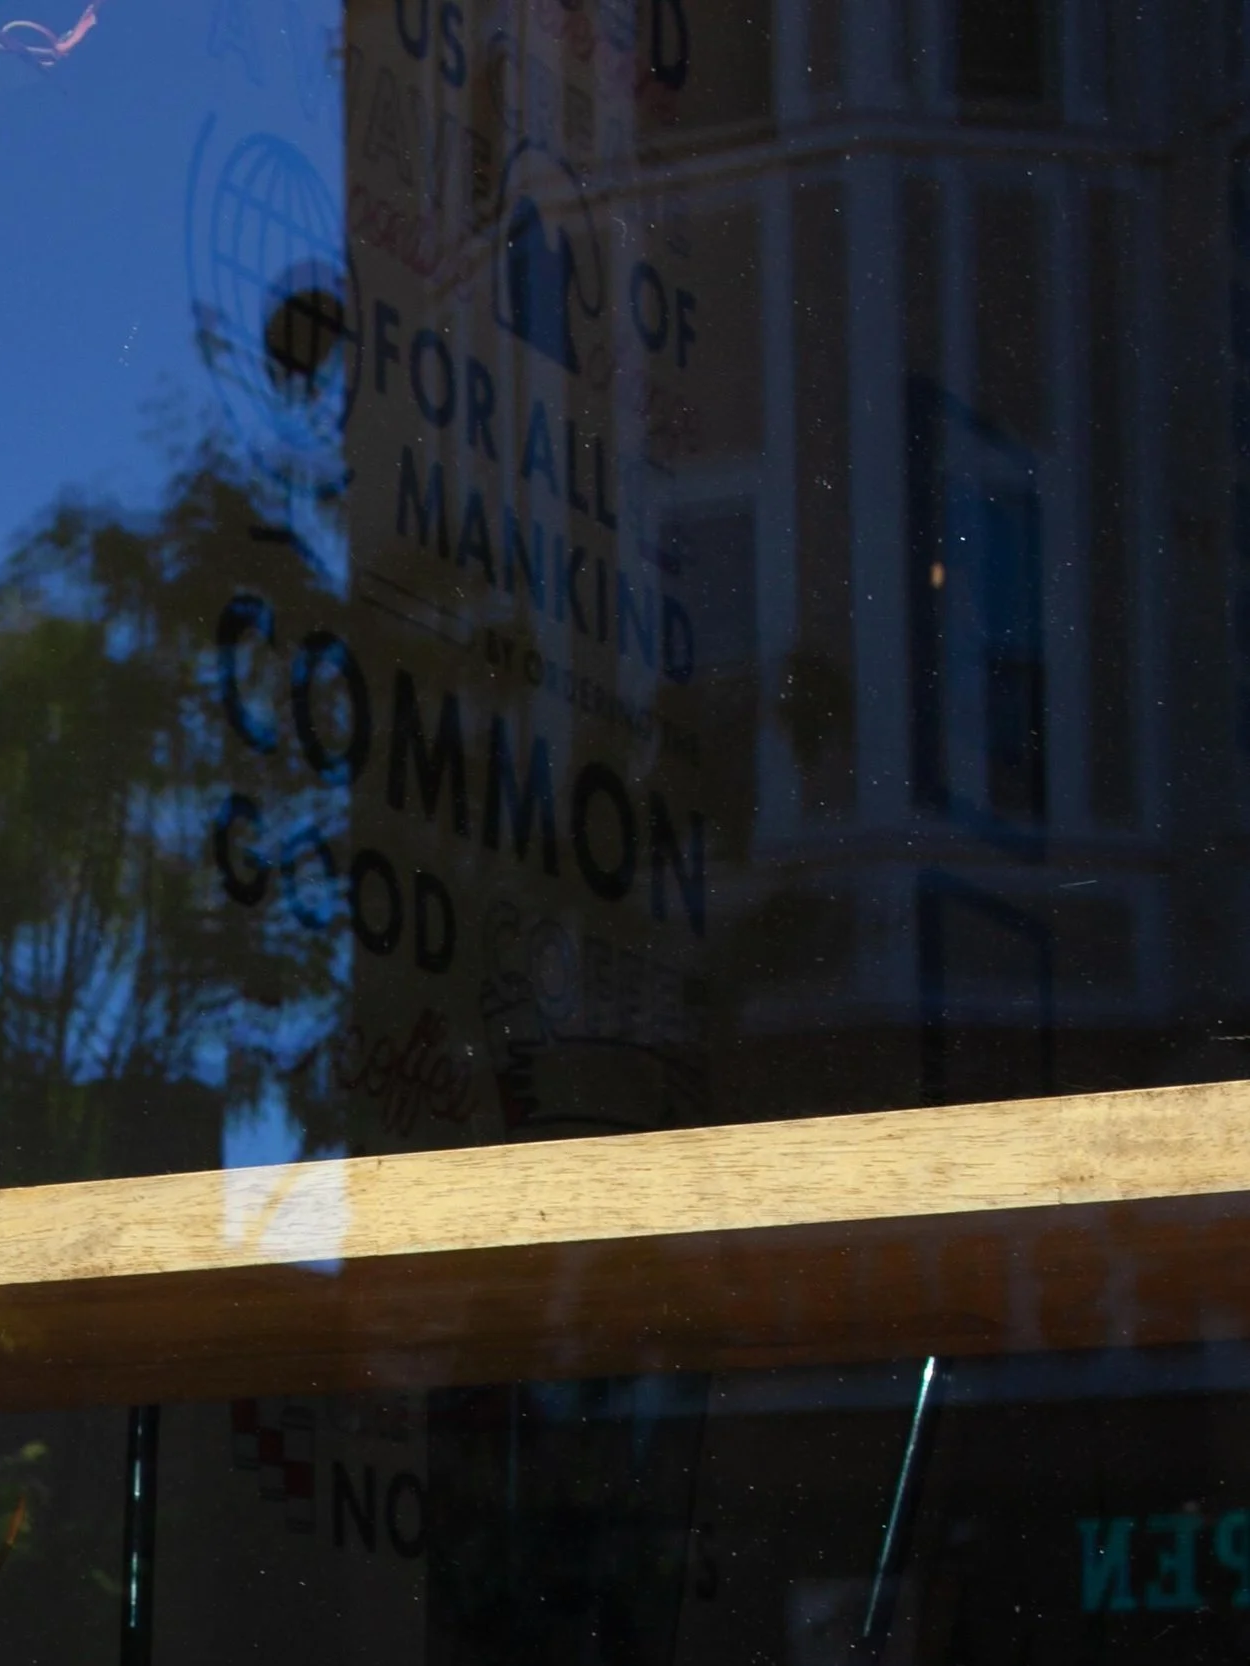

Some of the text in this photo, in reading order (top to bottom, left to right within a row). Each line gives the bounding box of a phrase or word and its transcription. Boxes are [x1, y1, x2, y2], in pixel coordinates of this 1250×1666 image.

[373, 298, 497, 460] FOR
[520, 401, 617, 530] ALL
[630, 262, 697, 368] OF
[395, 444, 694, 687] MANKIND
[212, 792, 456, 974] GOOD
[215, 594, 706, 940] COMMON
